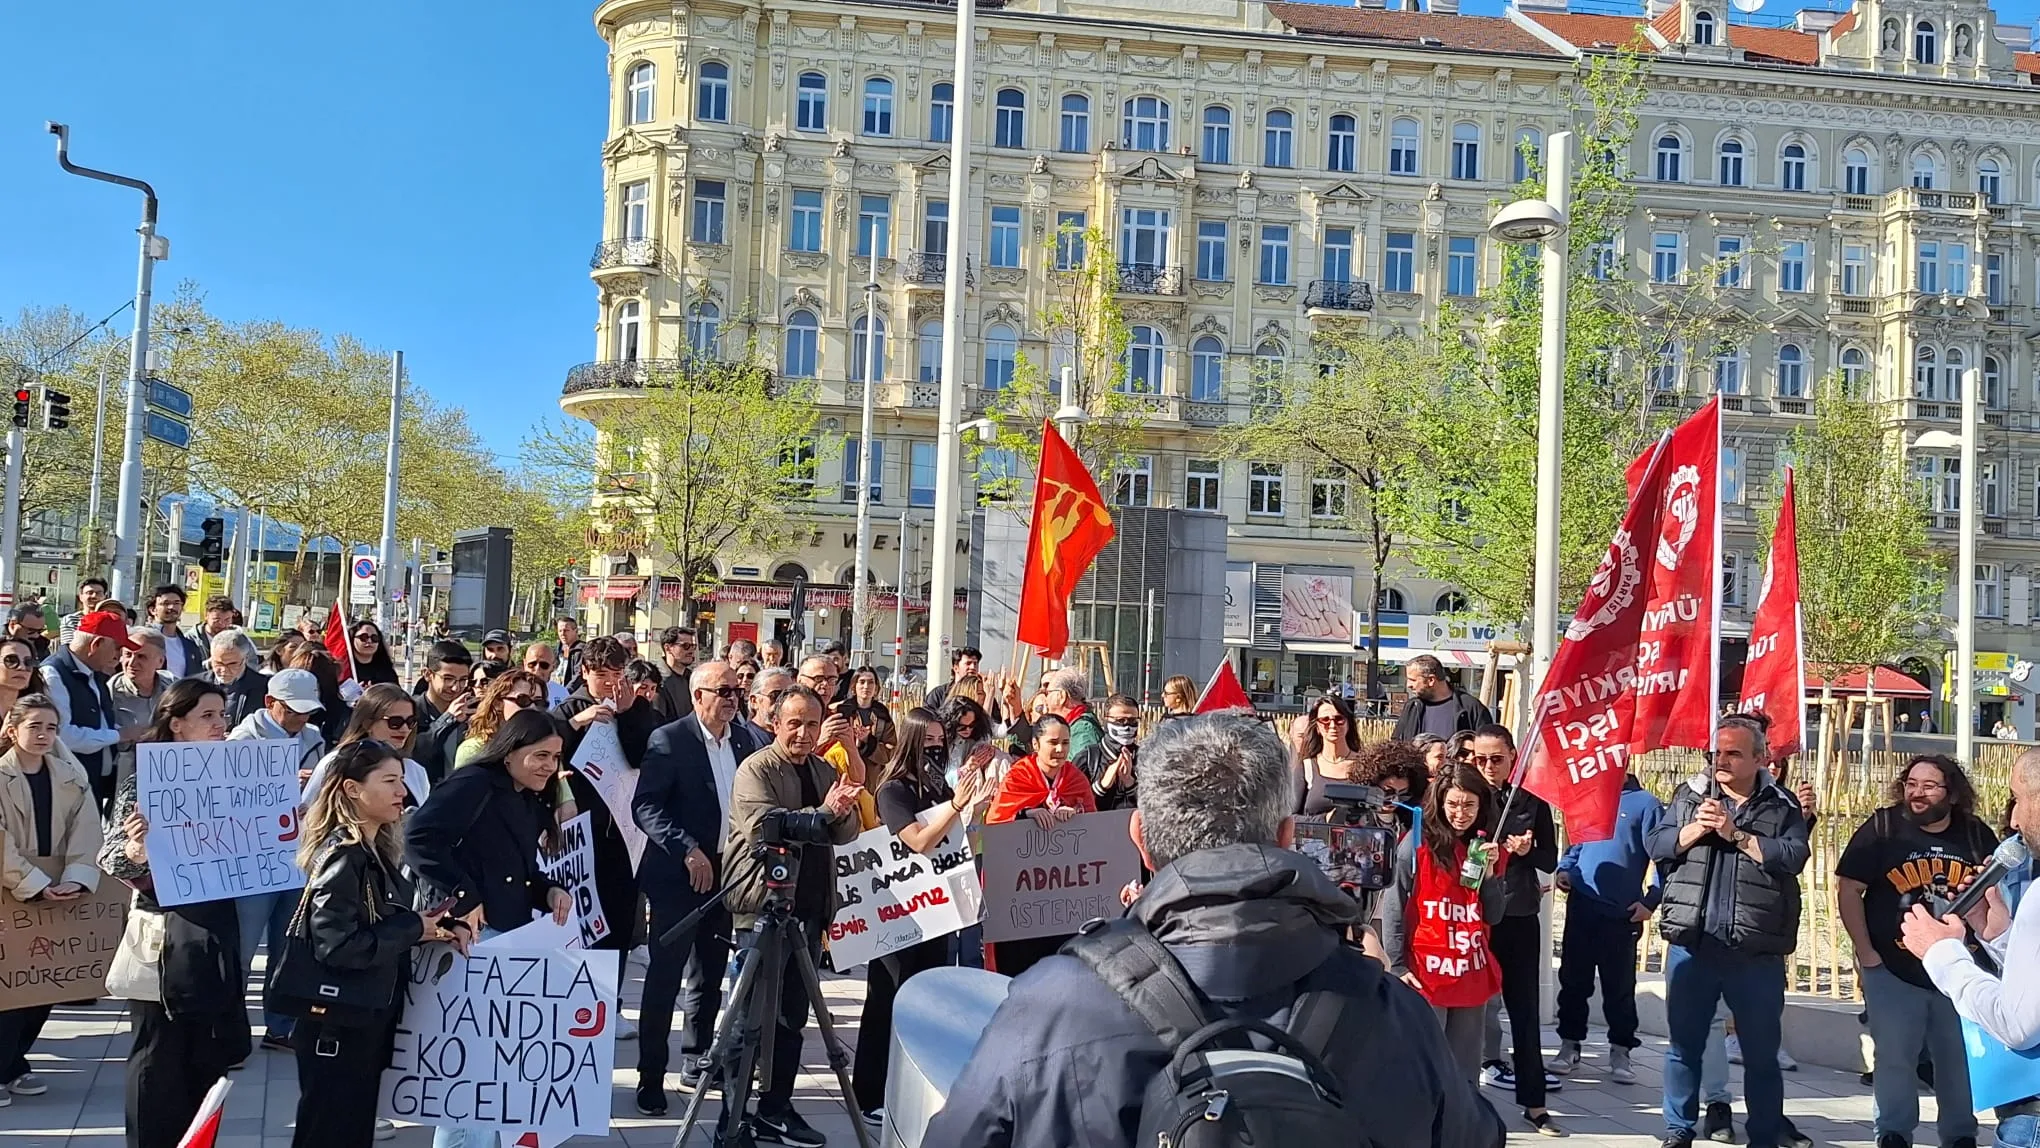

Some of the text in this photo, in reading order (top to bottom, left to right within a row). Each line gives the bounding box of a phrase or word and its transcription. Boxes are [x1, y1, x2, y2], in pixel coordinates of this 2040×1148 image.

[148, 787, 192, 823] FOR
[196, 786, 226, 819] ME
[161, 815, 274, 858] TÜRKİYE
[1016, 828, 1088, 859] JUST
[210, 856, 254, 892] THE
[256, 849, 301, 887] BEST
[1015, 860, 1108, 892] ADALET
[830, 914, 869, 941] EMİR
[1010, 894, 1112, 929] İSTEMEK
[1423, 896, 1481, 922] TÜRK
[464, 955, 600, 1001] FAZLA
[437, 992, 559, 1041] YANDI
[494, 1040, 600, 1084] MODA
[391, 1074, 580, 1128] GEÇELİM
